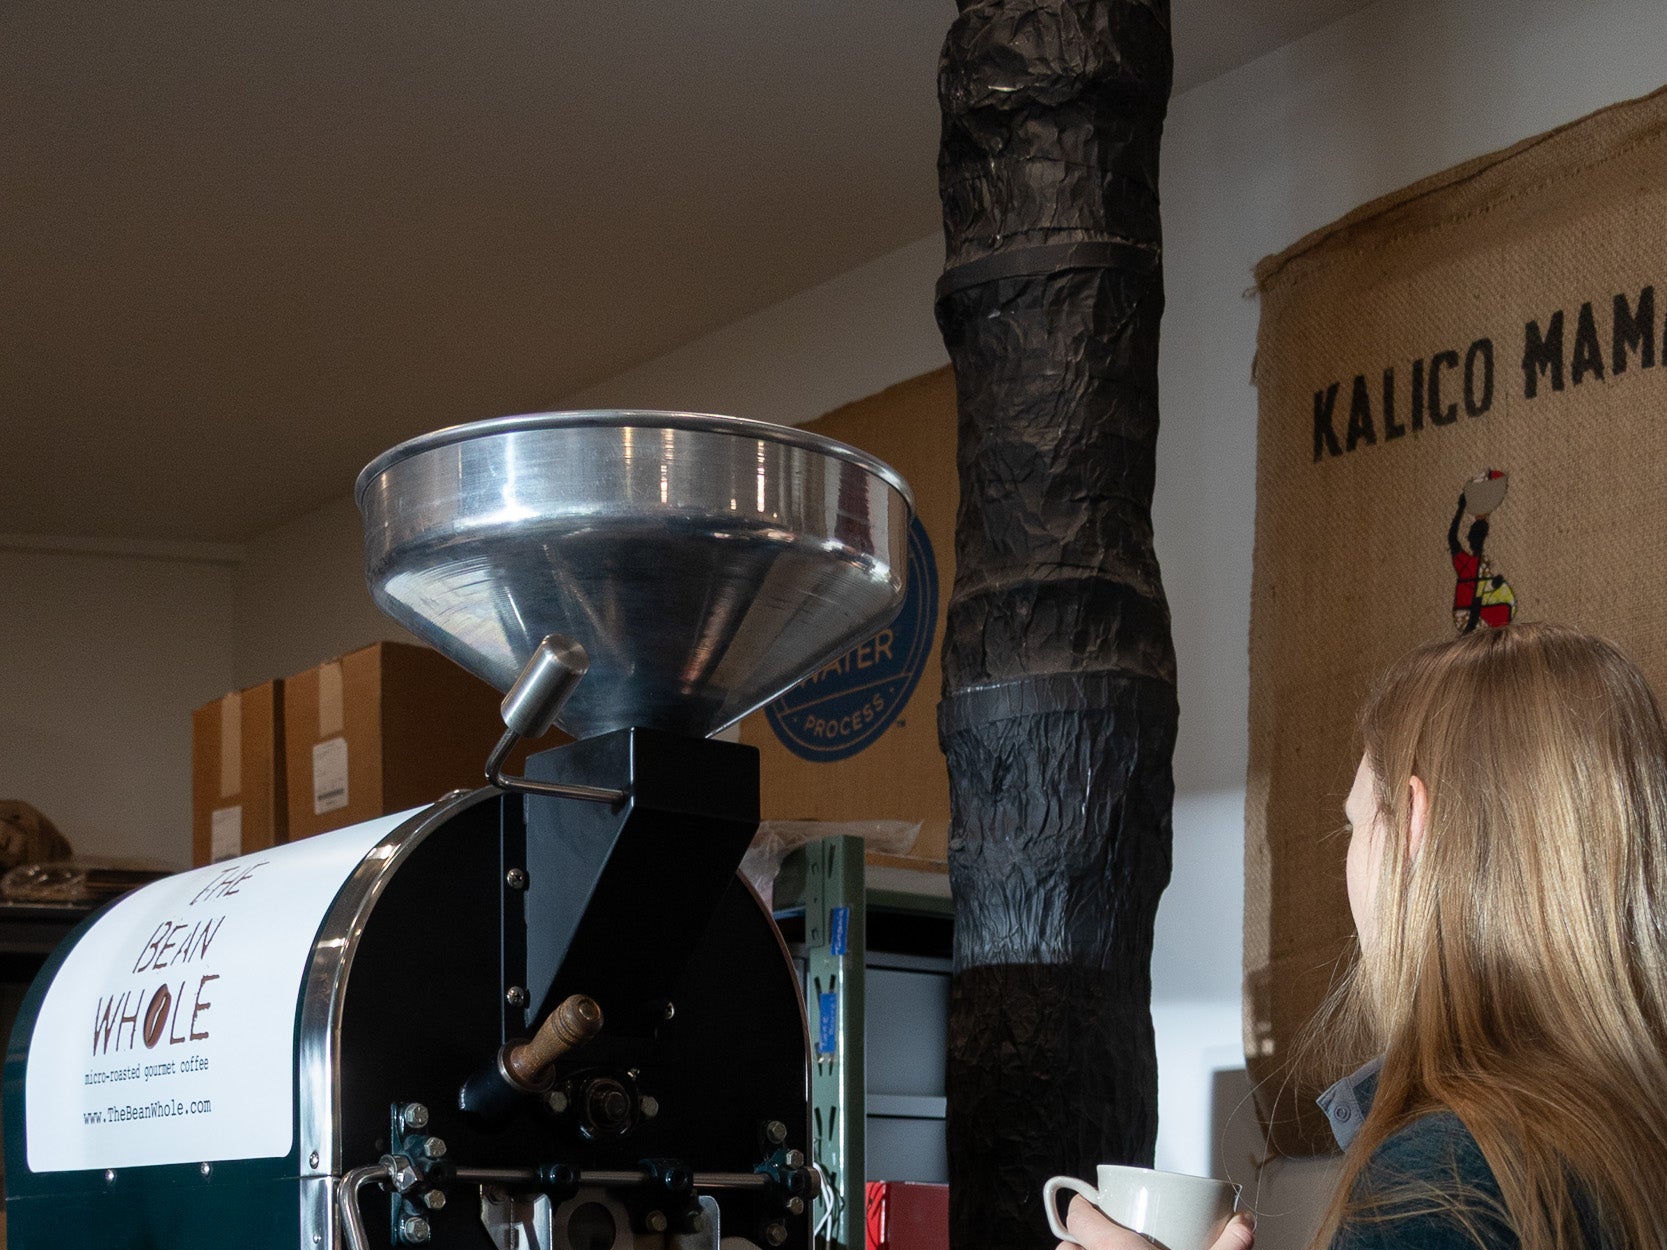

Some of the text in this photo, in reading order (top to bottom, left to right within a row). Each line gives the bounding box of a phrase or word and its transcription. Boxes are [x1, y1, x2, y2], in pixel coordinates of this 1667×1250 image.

[1313, 338, 1494, 463] KALICO
[805, 693, 884, 738] PROCESS
[190, 861, 270, 906] THE
[132, 915, 226, 974] BEAN
[93, 974, 220, 1056] WHOLE
[84, 1055, 209, 1085] micro-roasted gourmet coffee
[83, 1098, 212, 1125] www.TheBeanWhole.com
